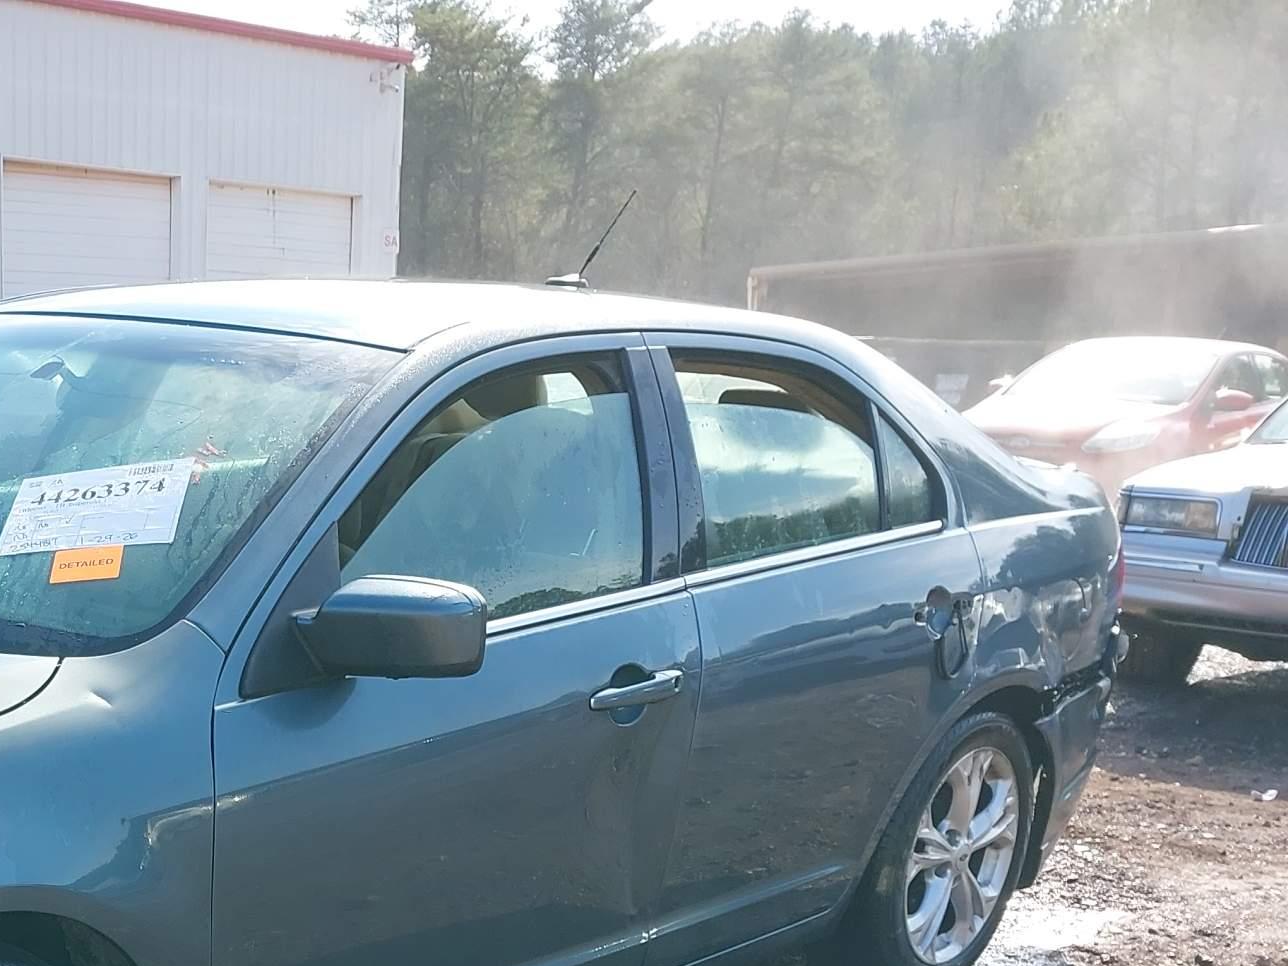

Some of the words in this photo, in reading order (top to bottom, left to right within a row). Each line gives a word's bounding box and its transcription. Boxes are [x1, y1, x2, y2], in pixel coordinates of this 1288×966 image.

[384, 234, 398, 247] SA
[30, 477, 166, 506] 44263374
[58, 558, 114, 570] DETAILED
